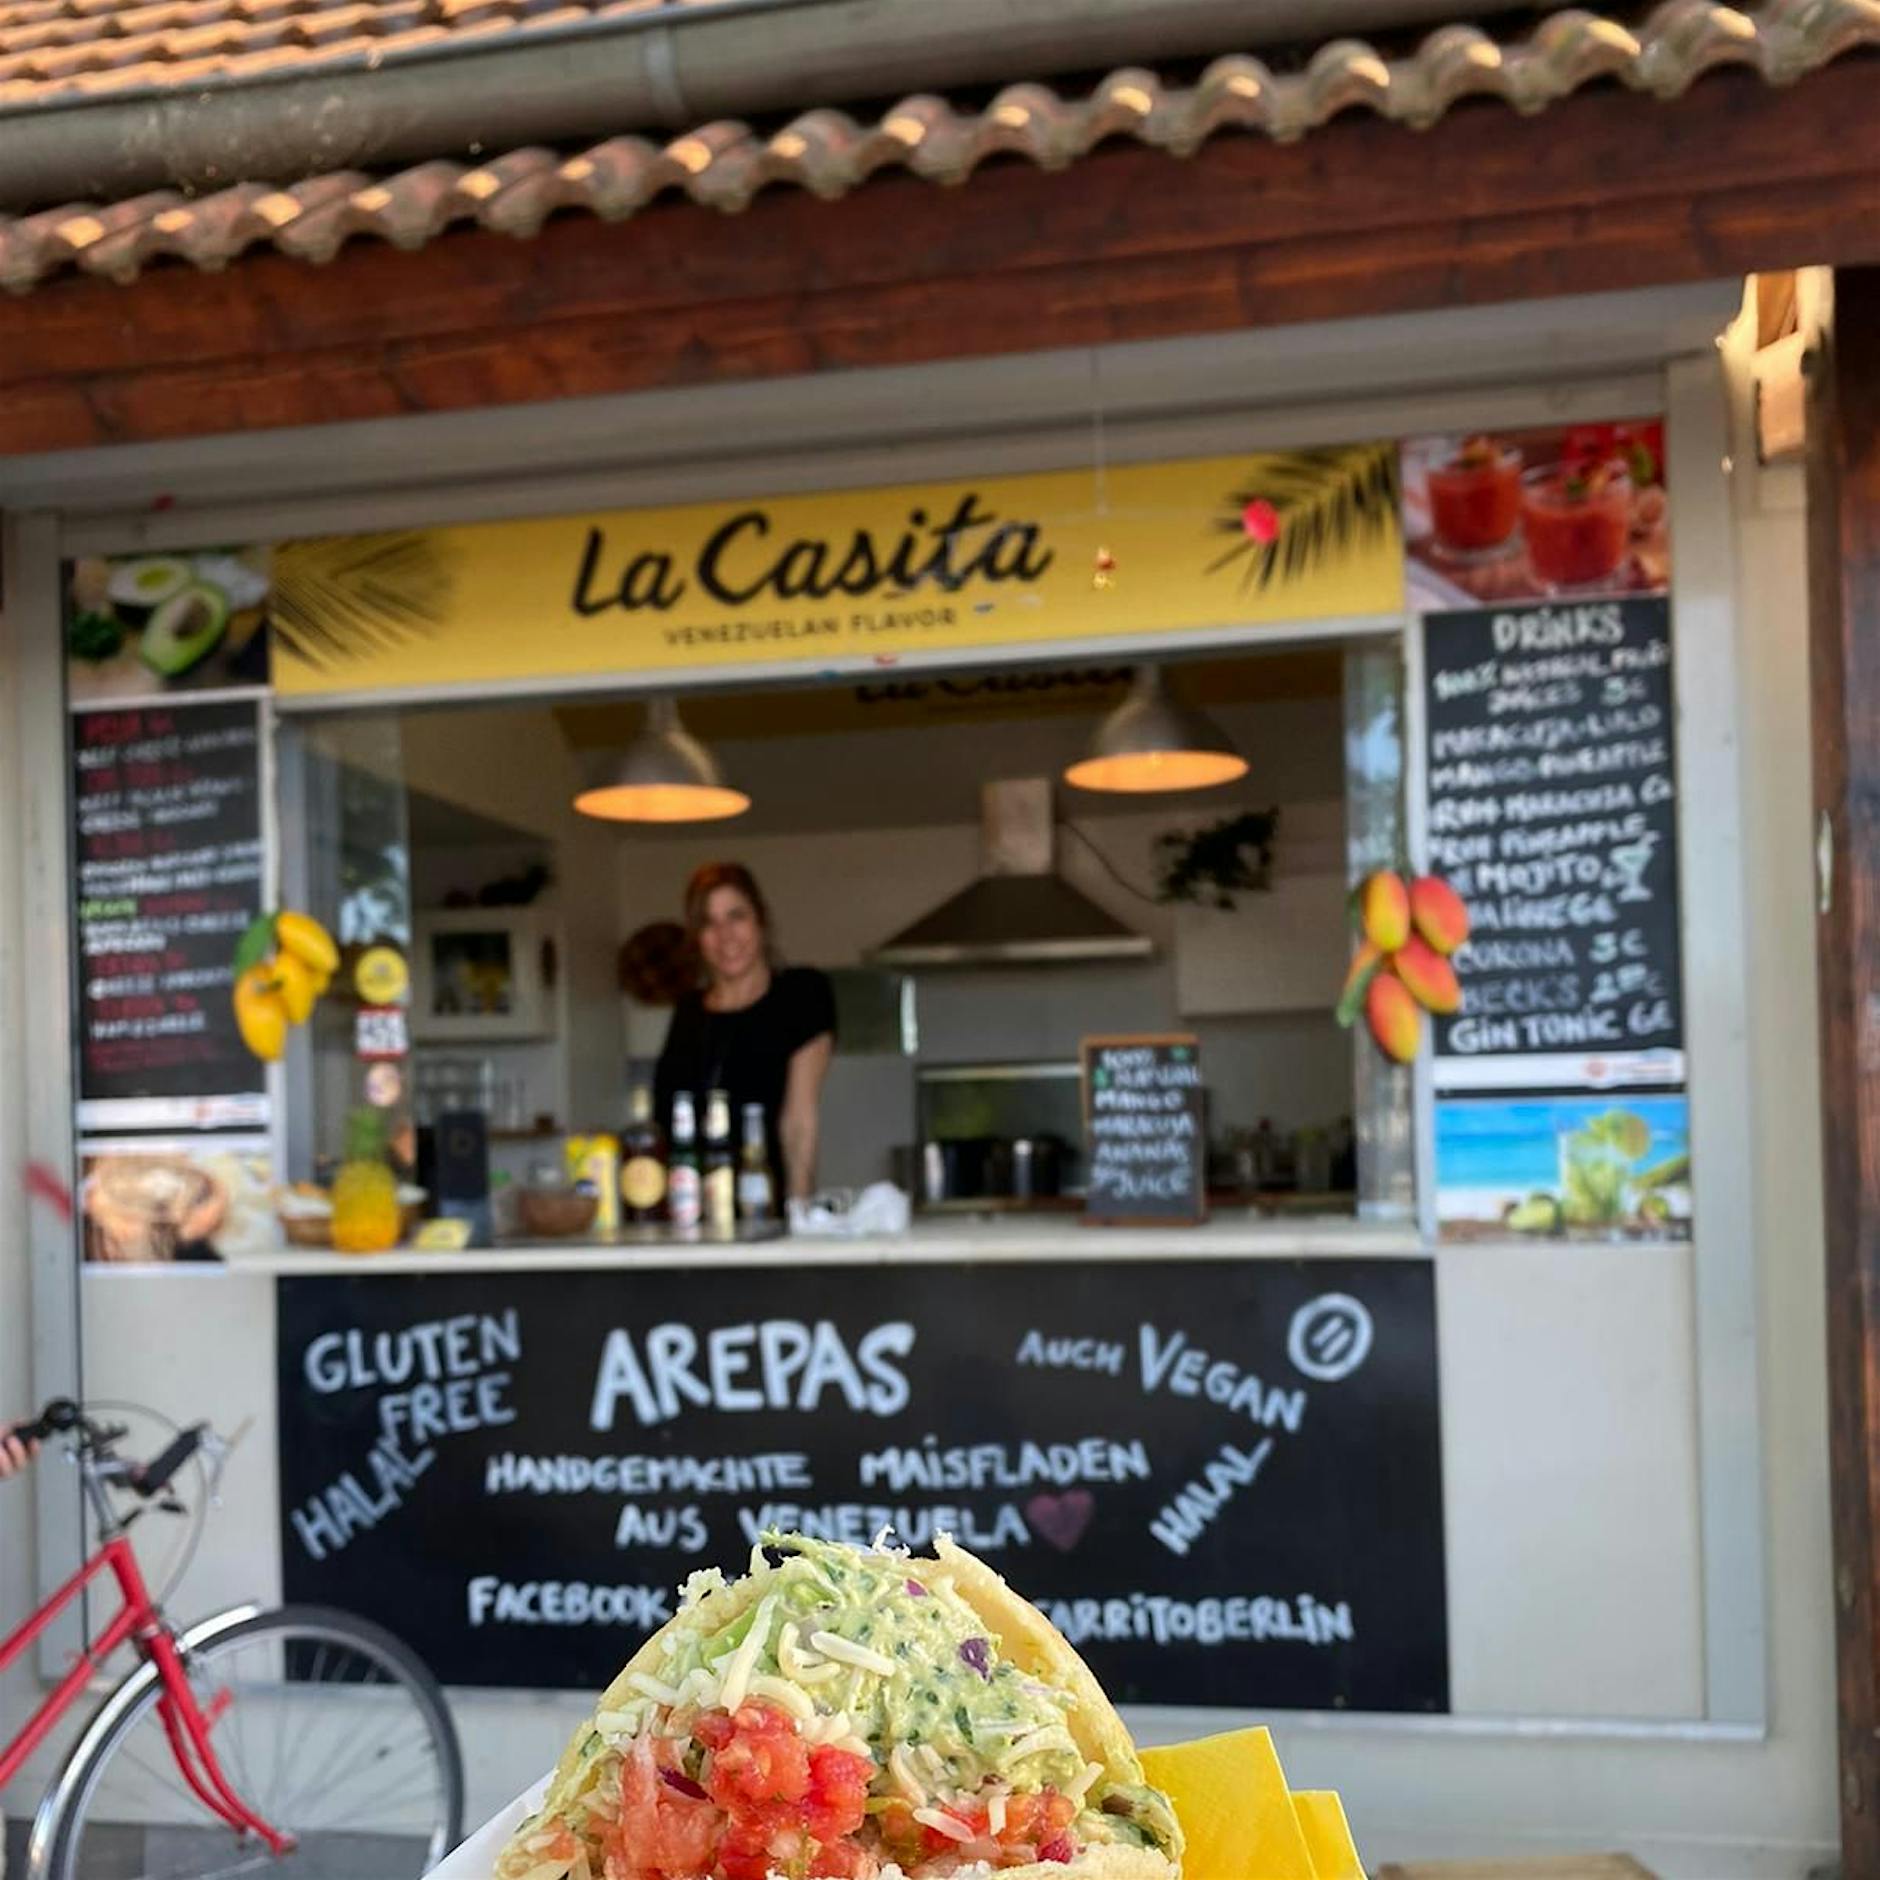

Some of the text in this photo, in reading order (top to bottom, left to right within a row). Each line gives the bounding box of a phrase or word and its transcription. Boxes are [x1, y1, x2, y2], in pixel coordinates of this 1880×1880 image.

[571, 494, 1054, 618] La Casita
[663, 607, 957, 647] VENEZUELAN FLAVOR
[1094, 1089, 1184, 1111] MANGO
[304, 1307, 521, 1394] GLUTEN
[590, 1320, 917, 1433] AREPAS
[1016, 1321, 1307, 1433] AUCH VEGAN
[378, 1372, 517, 1445] FREE
[291, 1432, 438, 1560] HALAL
[485, 1450, 813, 1495] HANDGEMACHTE
[1149, 1436, 1273, 1556] HALAL
[614, 1502, 1031, 1553] AUS VENEZUELA
[466, 1574, 674, 1629] FACEBOOK
